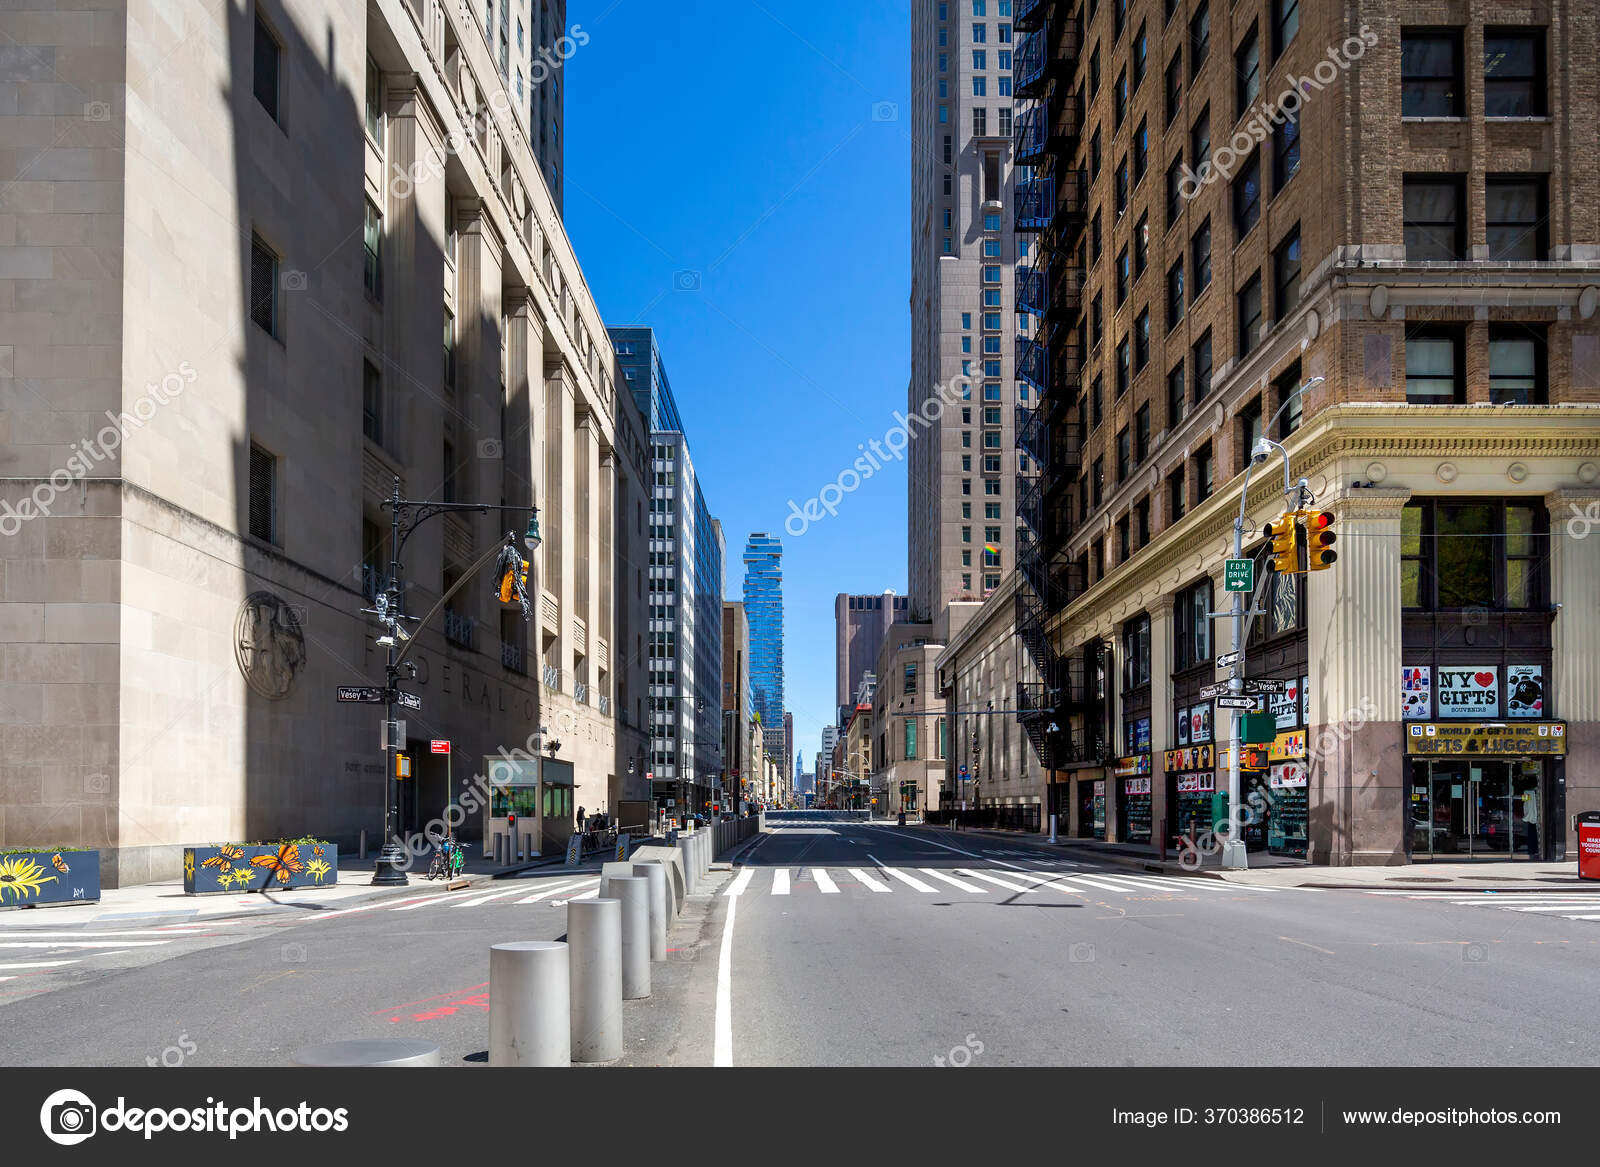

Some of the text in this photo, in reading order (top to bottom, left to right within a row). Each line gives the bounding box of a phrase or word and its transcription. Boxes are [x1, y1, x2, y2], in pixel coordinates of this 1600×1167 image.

[365, 634, 506, 713] FDERAL
[1439, 671, 1475, 688] NY
[1201, 688, 1217, 698] Church
[1259, 682, 1278, 692] Vesey
[340, 690, 361, 700] Vesey
[1439, 690, 1496, 705] GIFTS
[1270, 702, 1297, 717] GIFTS
[1438, 727, 1471, 736] WORLD
[1473, 727, 1486, 736] OF
[1487, 727, 1514, 736] GIFTS
[1416, 738, 1560, 753] GIFTS & LUGGAGE
